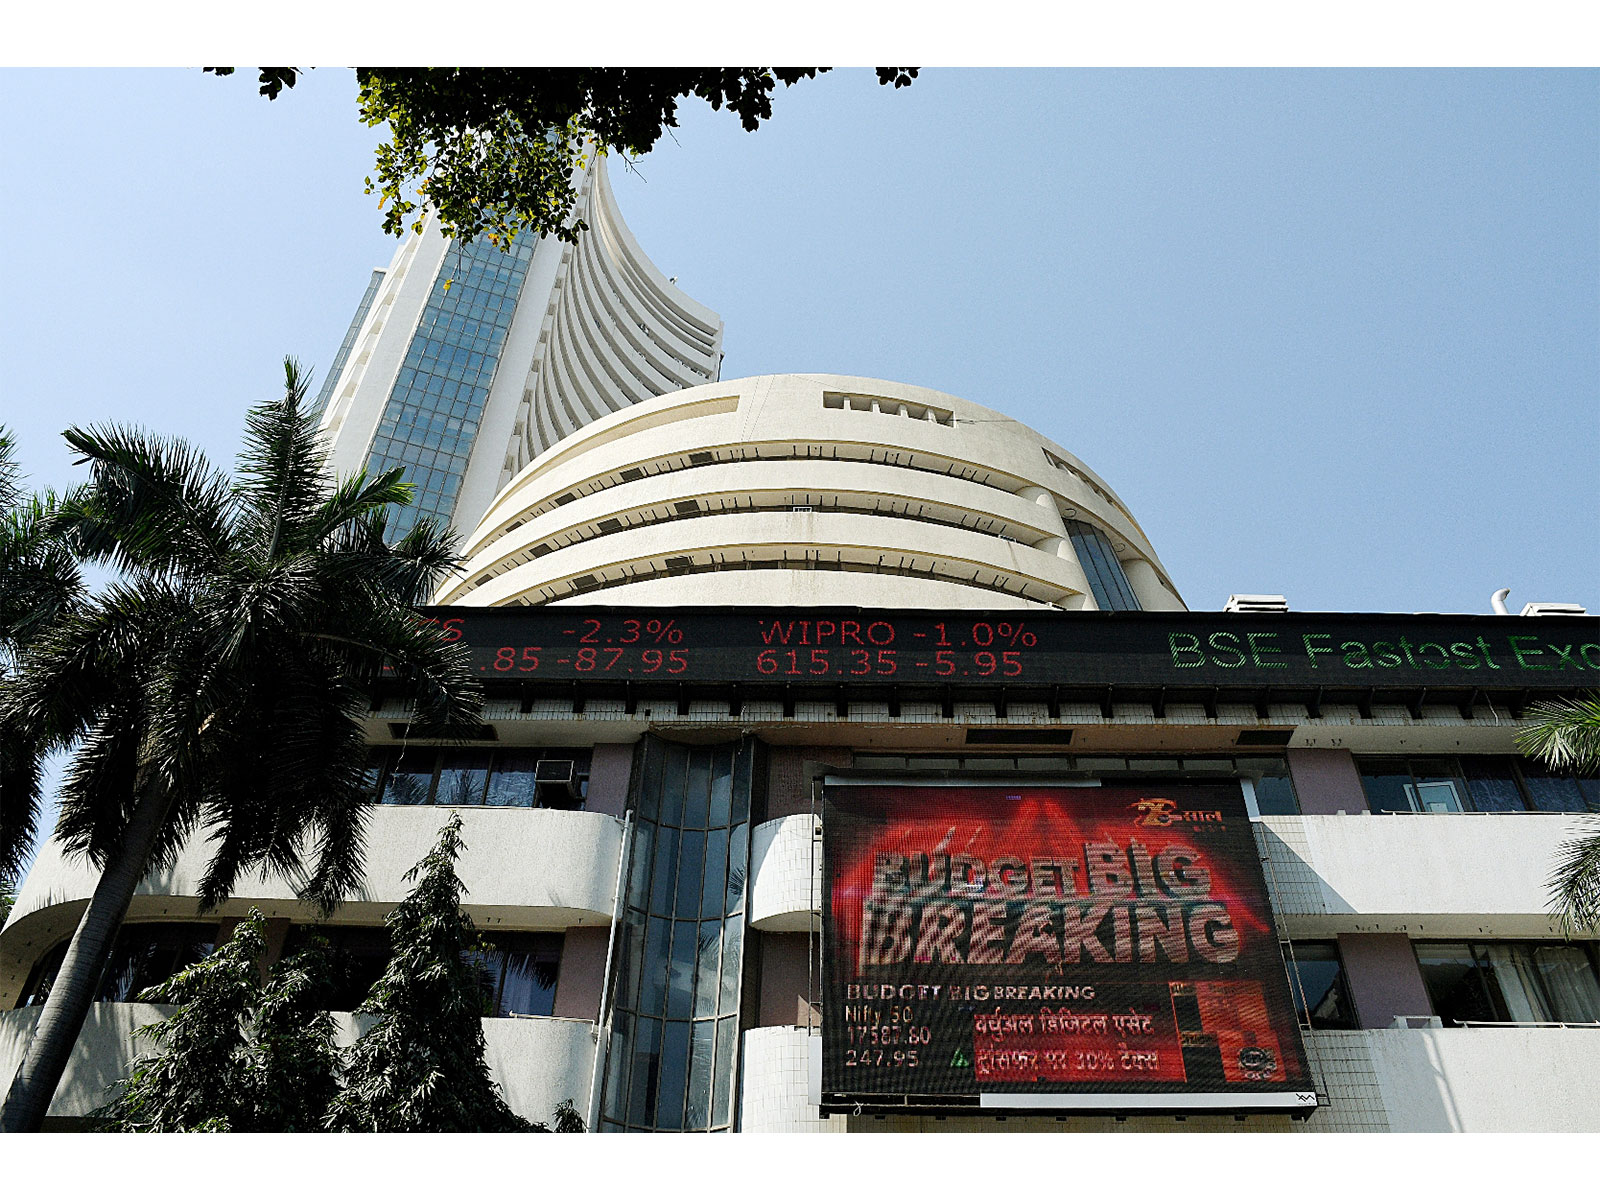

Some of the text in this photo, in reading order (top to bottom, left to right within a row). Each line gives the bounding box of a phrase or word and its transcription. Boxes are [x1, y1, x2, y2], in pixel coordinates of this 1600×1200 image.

[563, 619, 683, 644] -2.3%
[758, 620, 1038, 647] WIPRO -1.0%
[557, 647, 690, 674] -87.95
[757, 649, 1023, 677] 615.35 -5.95
[1168, 631, 1288, 668] BSE
[872, 842, 1212, 901] BUDGET BIG
[860, 900, 1240, 965] BREAKING
[993, 985, 1096, 1000] BREAKING
[890, 1005, 915, 1024] 50
[845, 1049, 920, 1067] 247.95
